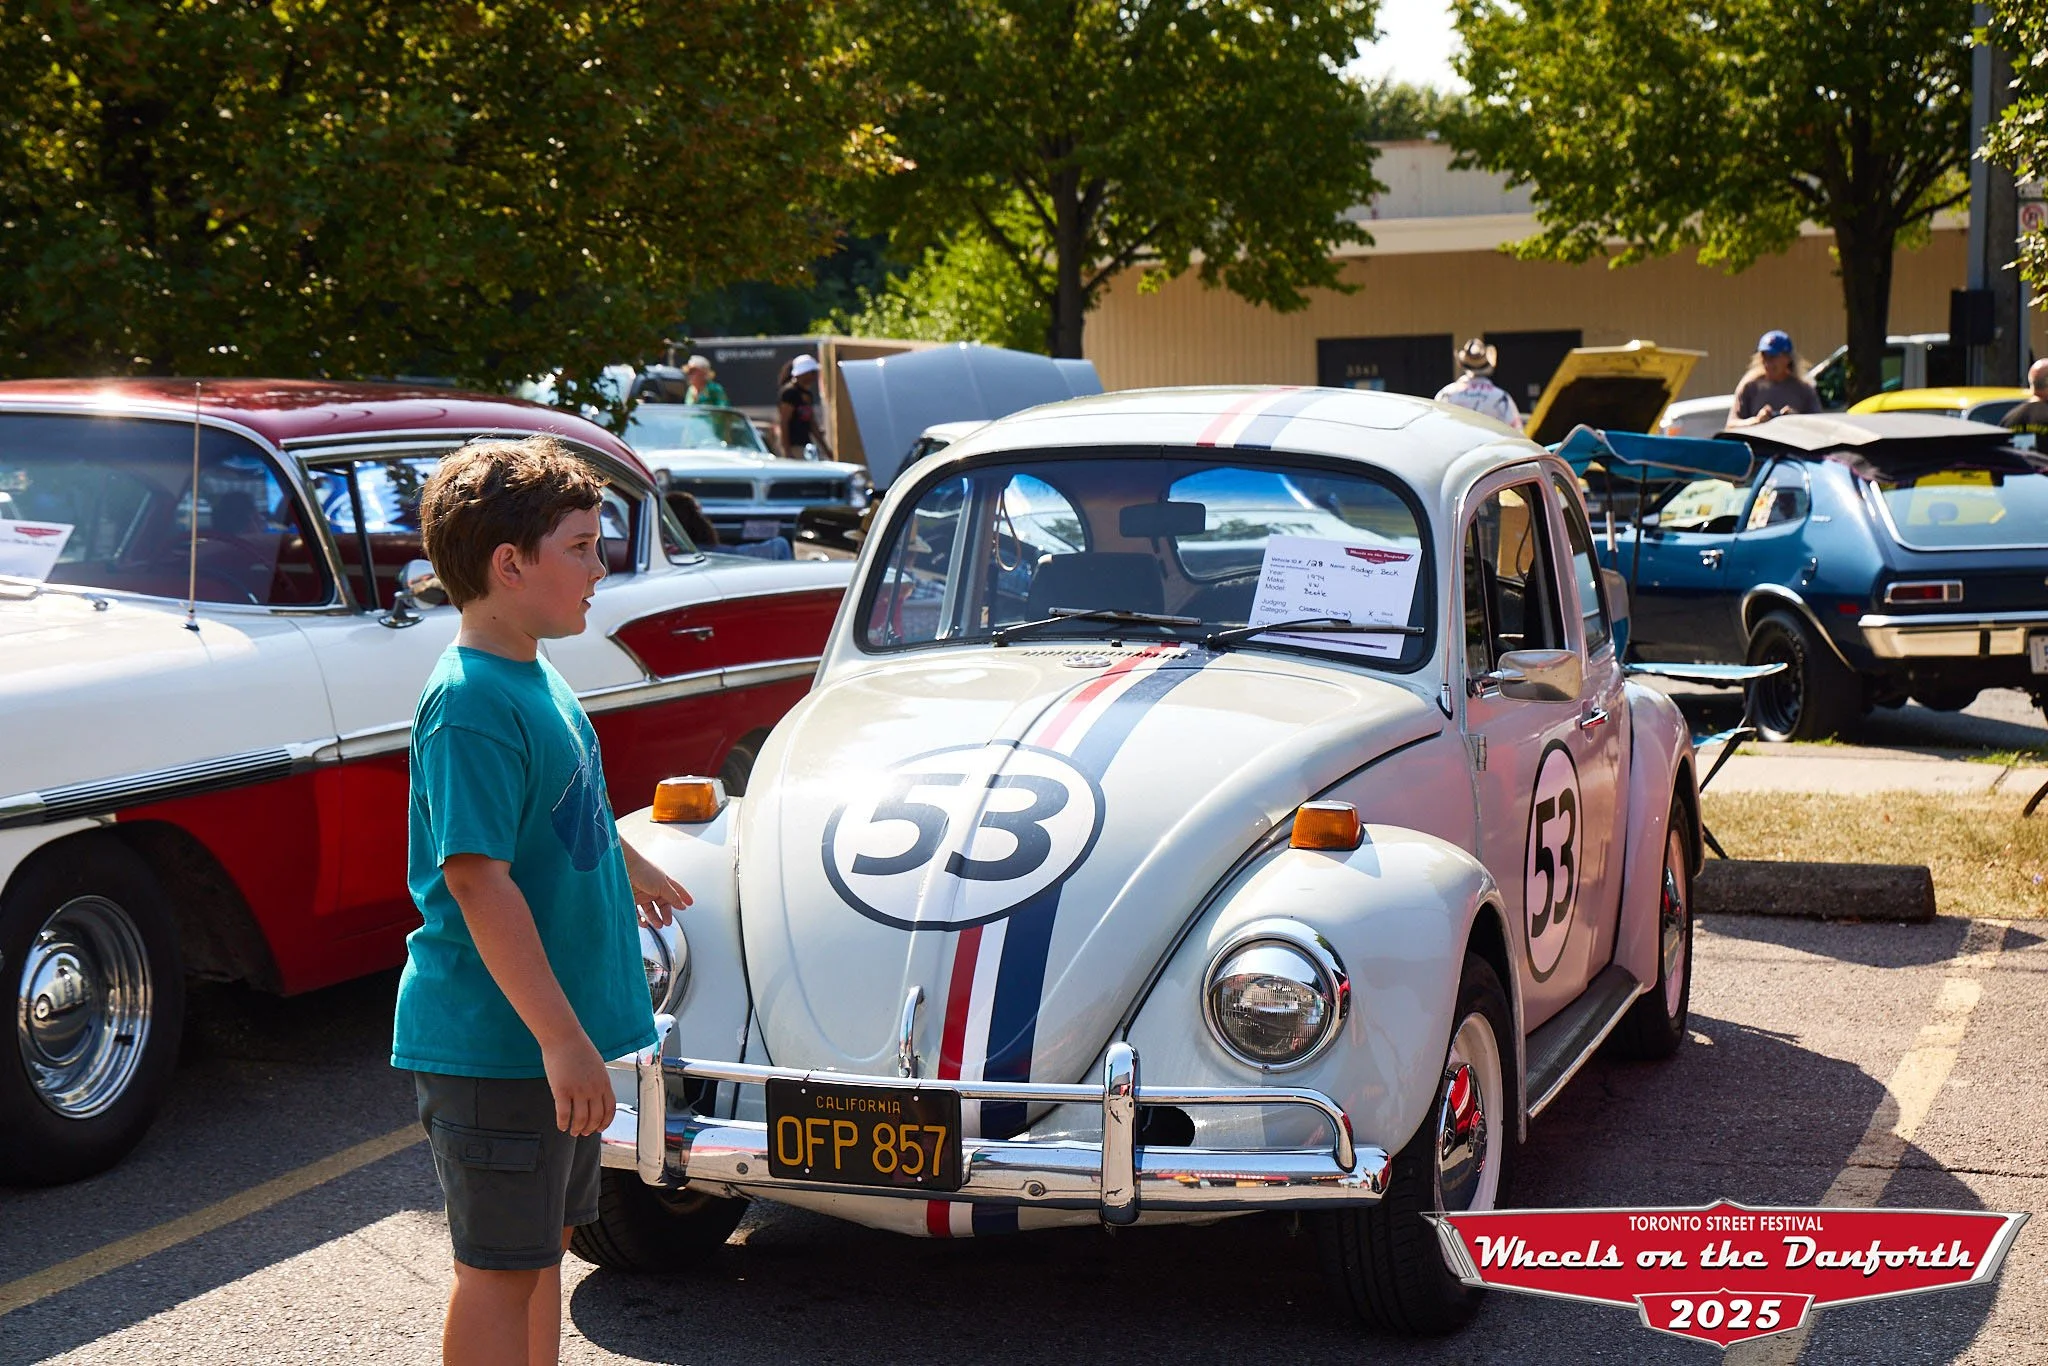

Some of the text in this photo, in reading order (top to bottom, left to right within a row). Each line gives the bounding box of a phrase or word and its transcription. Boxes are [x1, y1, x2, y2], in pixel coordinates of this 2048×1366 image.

[1306, 559, 1323, 568] 128
[1380, 568, 1399, 576] Beck
[1307, 573, 1325, 582] 1974
[1304, 588, 1327, 597] Beetle
[1260, 605, 1288, 615] Category
[1298, 605, 1322, 613] Classic
[1261, 598, 1287, 607] Judging
[851, 773, 1070, 882] 53
[1531, 787, 1576, 938] 53
[816, 1095, 901, 1114] CALIFORNIA
[776, 1115, 947, 1177] OFP 857
